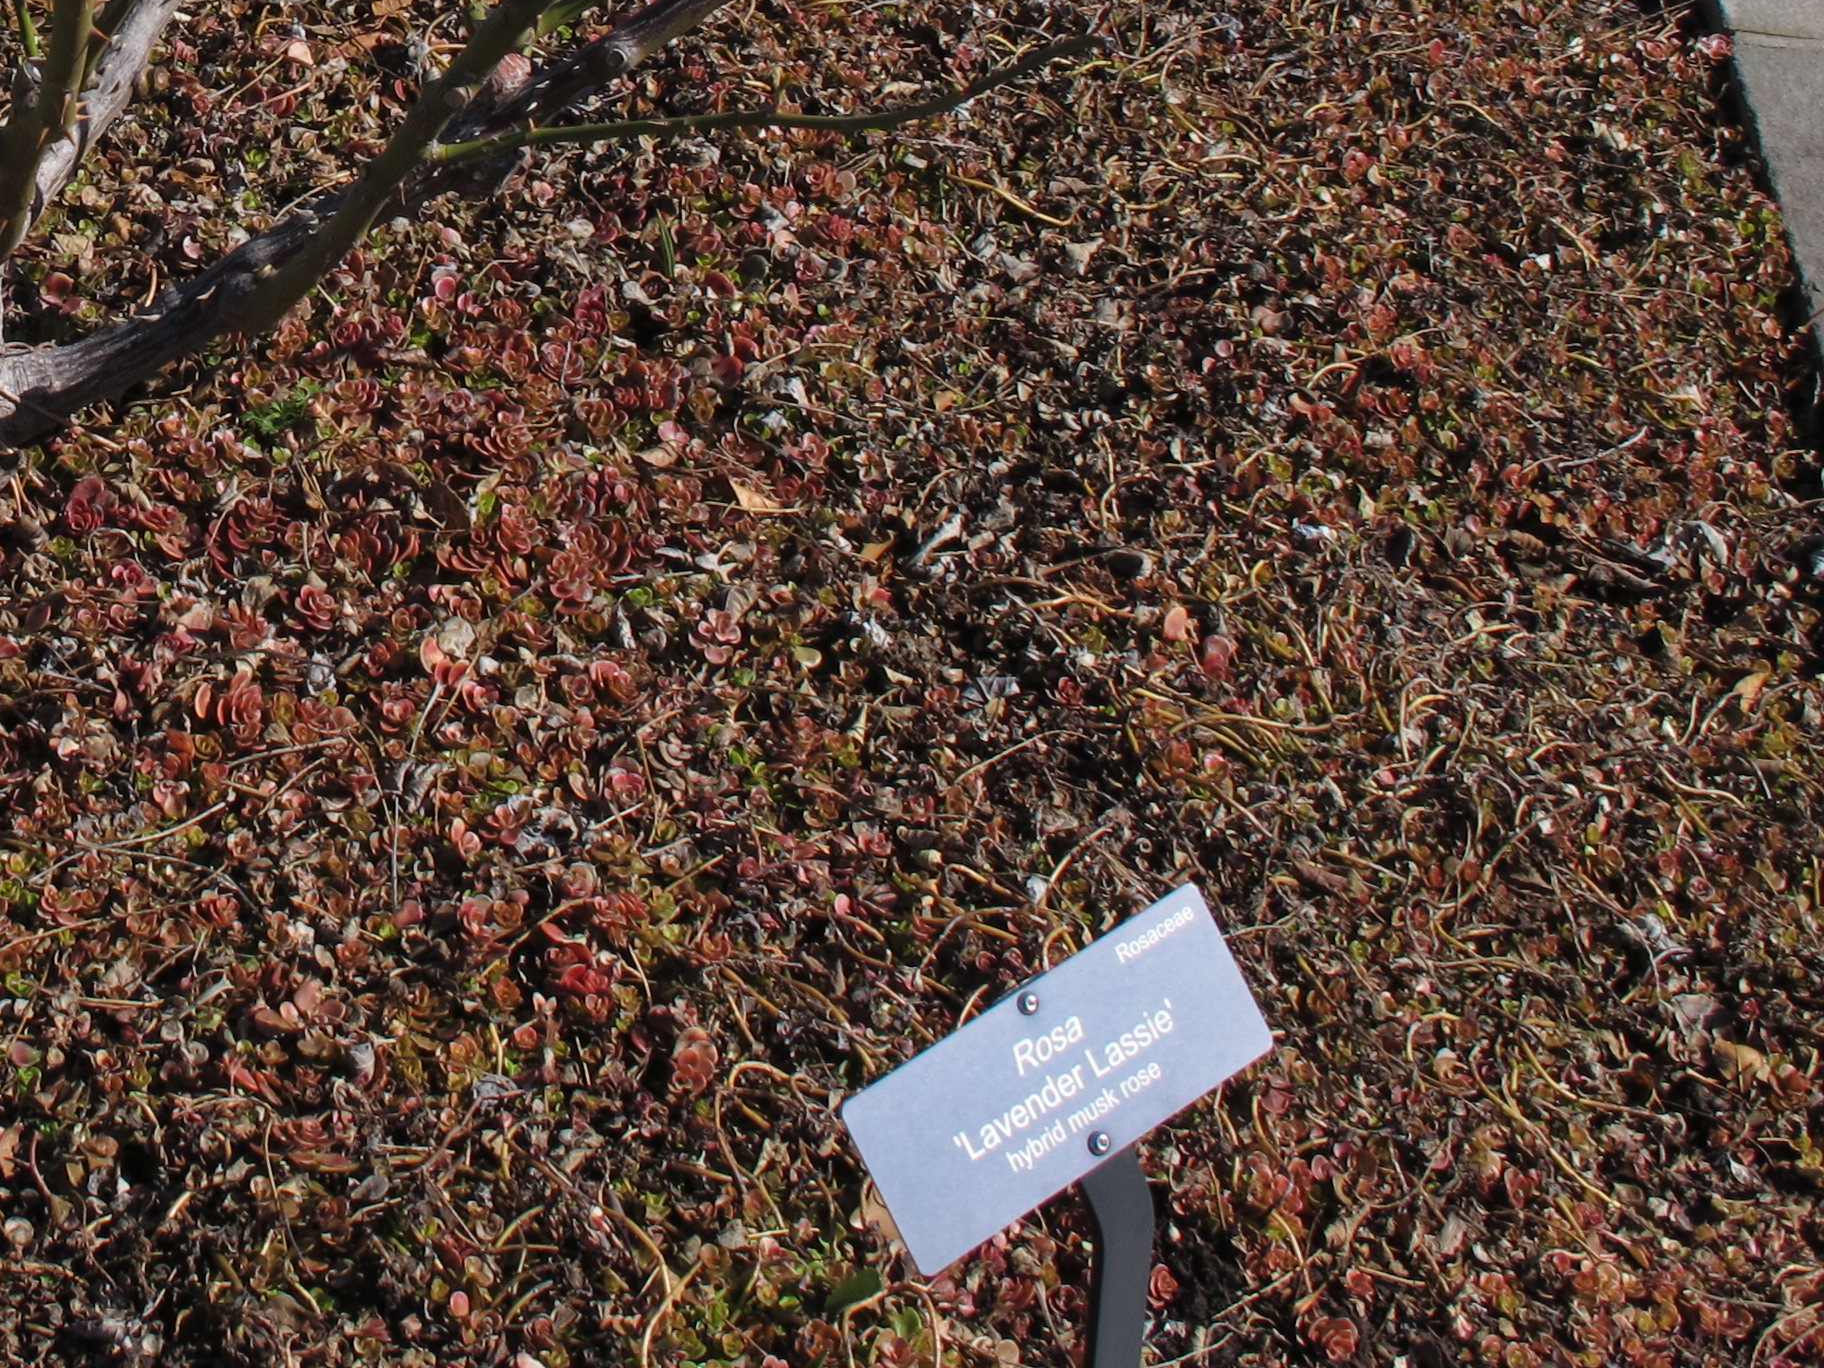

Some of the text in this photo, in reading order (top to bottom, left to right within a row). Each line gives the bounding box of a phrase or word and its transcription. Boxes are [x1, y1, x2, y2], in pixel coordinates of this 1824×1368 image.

[1114, 905, 1194, 963] Rosaceae
[953, 997, 1174, 1161] 'Lavender Lassie'
[1012, 1015, 1084, 1076] Rosa
[1005, 1061, 1162, 1172] hybrid musk rose
